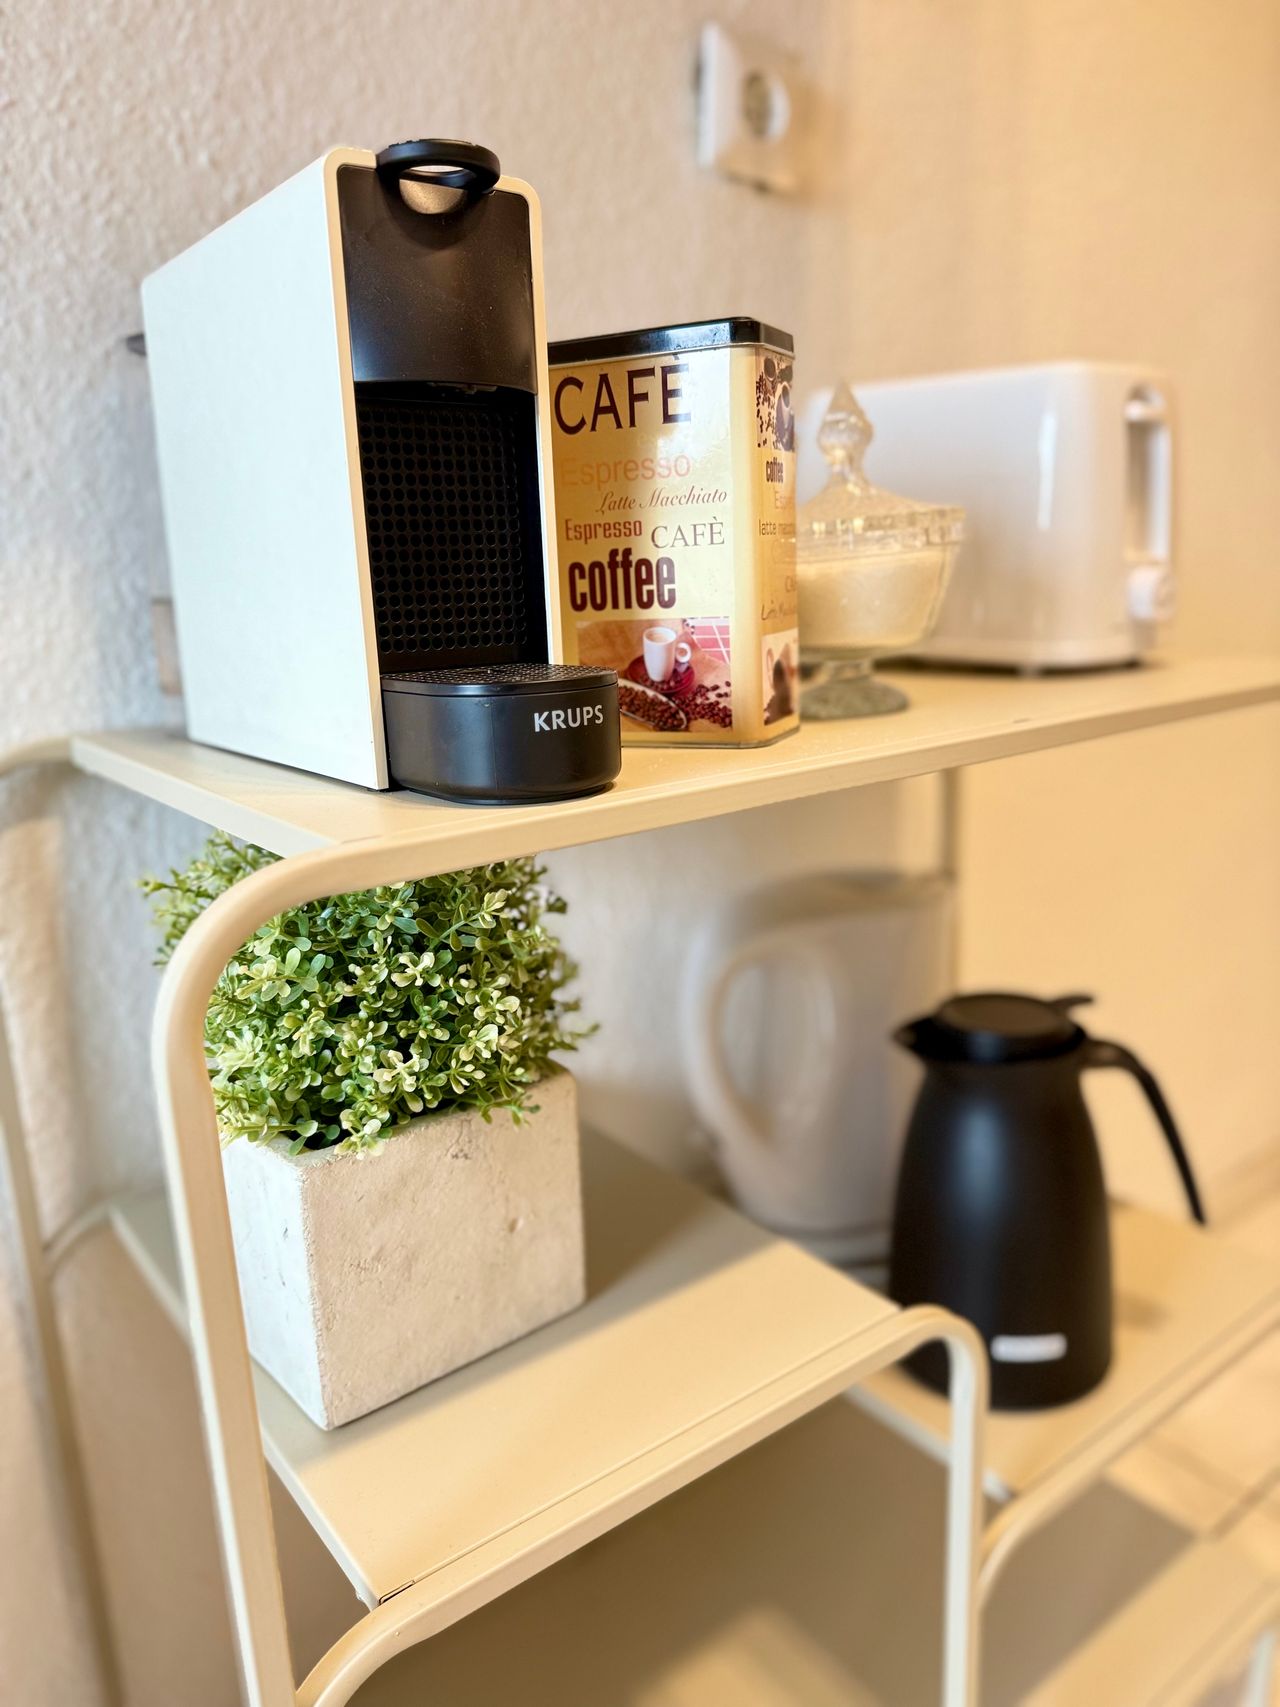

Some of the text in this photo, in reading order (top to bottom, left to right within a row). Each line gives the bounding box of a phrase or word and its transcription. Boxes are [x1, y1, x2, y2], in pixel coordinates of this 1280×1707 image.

[554, 353, 692, 435] CAFÈ
[560, 455, 691, 491] Espresso
[765, 456, 784, 482] coffee
[596, 485, 728, 515] Latte Macchiato
[565, 516, 725, 549] Espresso CAFÈ
[568, 547, 677, 612] coffee
[533, 704, 604, 733] KRUPS
